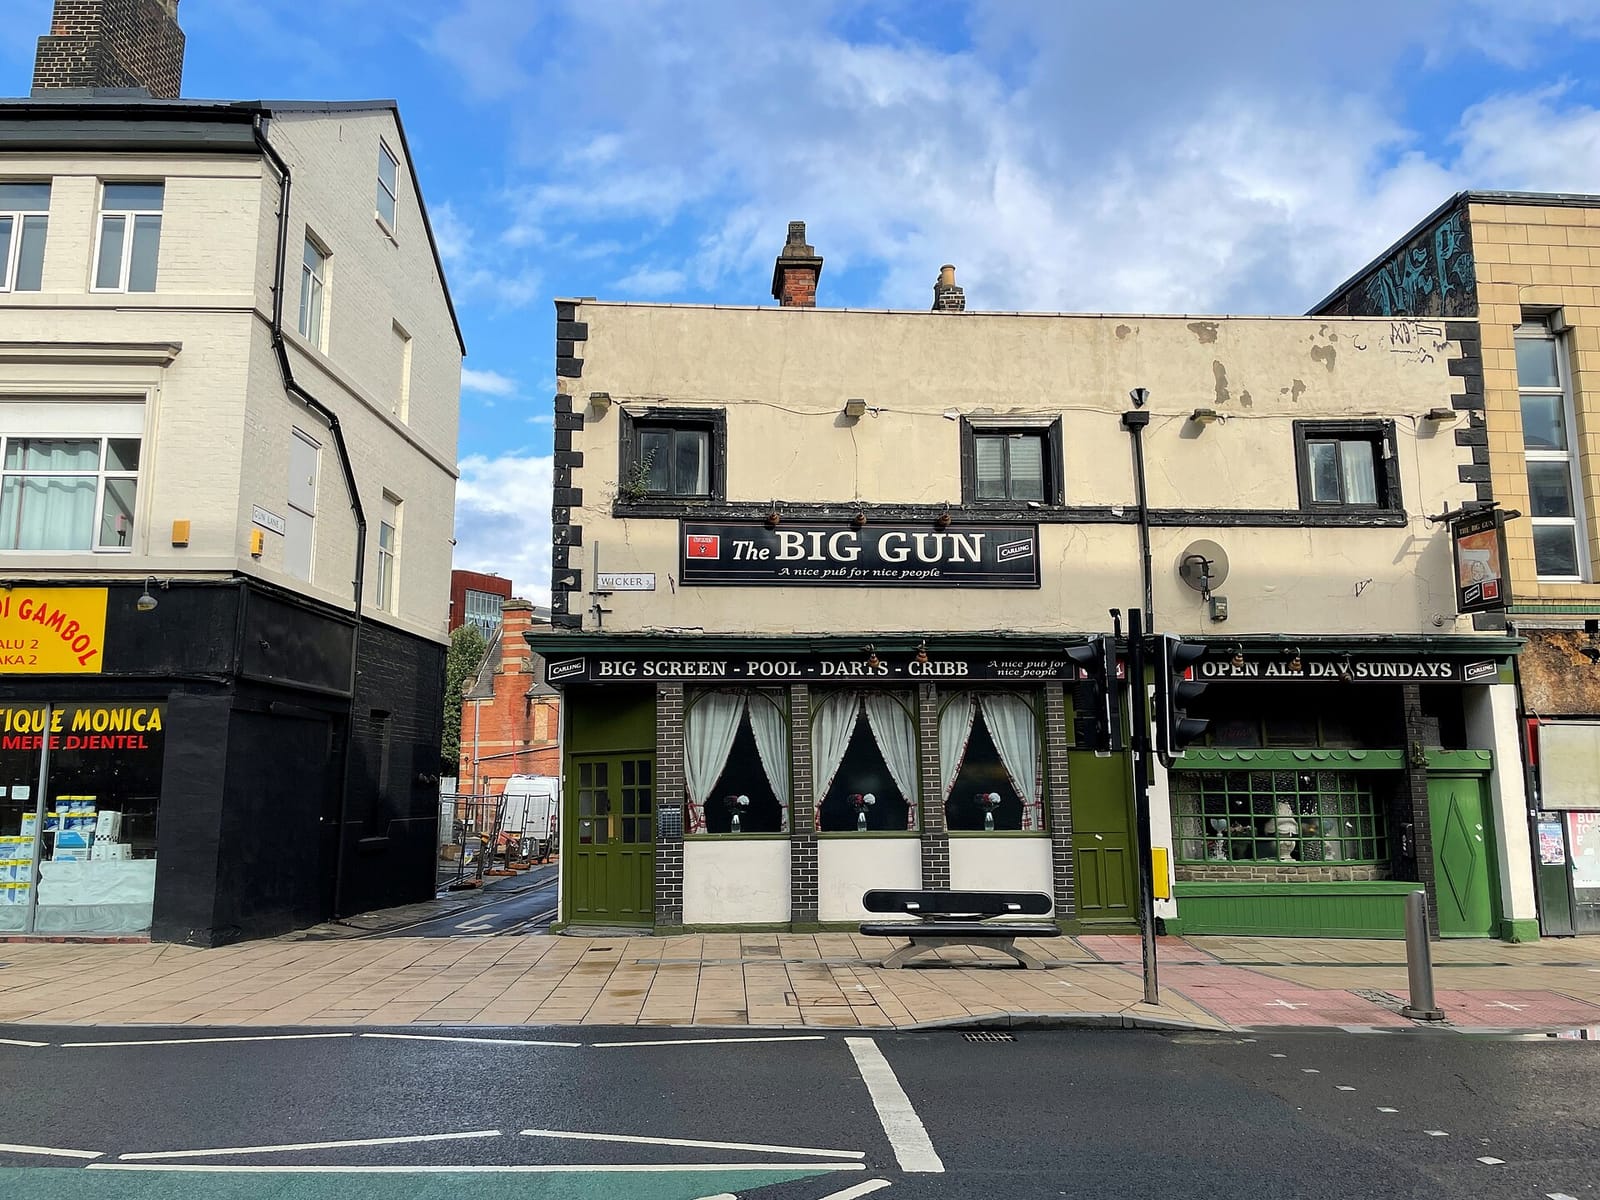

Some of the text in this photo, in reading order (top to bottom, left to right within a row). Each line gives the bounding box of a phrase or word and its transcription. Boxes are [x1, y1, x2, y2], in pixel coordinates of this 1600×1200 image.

[732, 530, 986, 563] The BIG GUN
[778, 567, 940, 579] A nice pub for nice people
[601, 577, 643, 586] WICKER
[18, 598, 98, 666] GAMBOL
[30, 639, 39, 649] 2
[28, 655, 37, 665] 2
[987, 660, 1067, 670] A nice pub for
[598, 661, 638, 676] BIG
[643, 661, 728, 676] SCREEN
[746, 661, 801, 676] POOL
[820, 661, 889, 676] DARTS
[908, 661, 969, 676] CRIBB
[997, 668, 1058, 678] nice people
[1202, 661, 1260, 677] OPEN
[1355, 662, 1453, 677] SUNDAYS
[71, 707, 162, 732] MONICA
[2, 735, 148, 750] MERE DJENTEL
